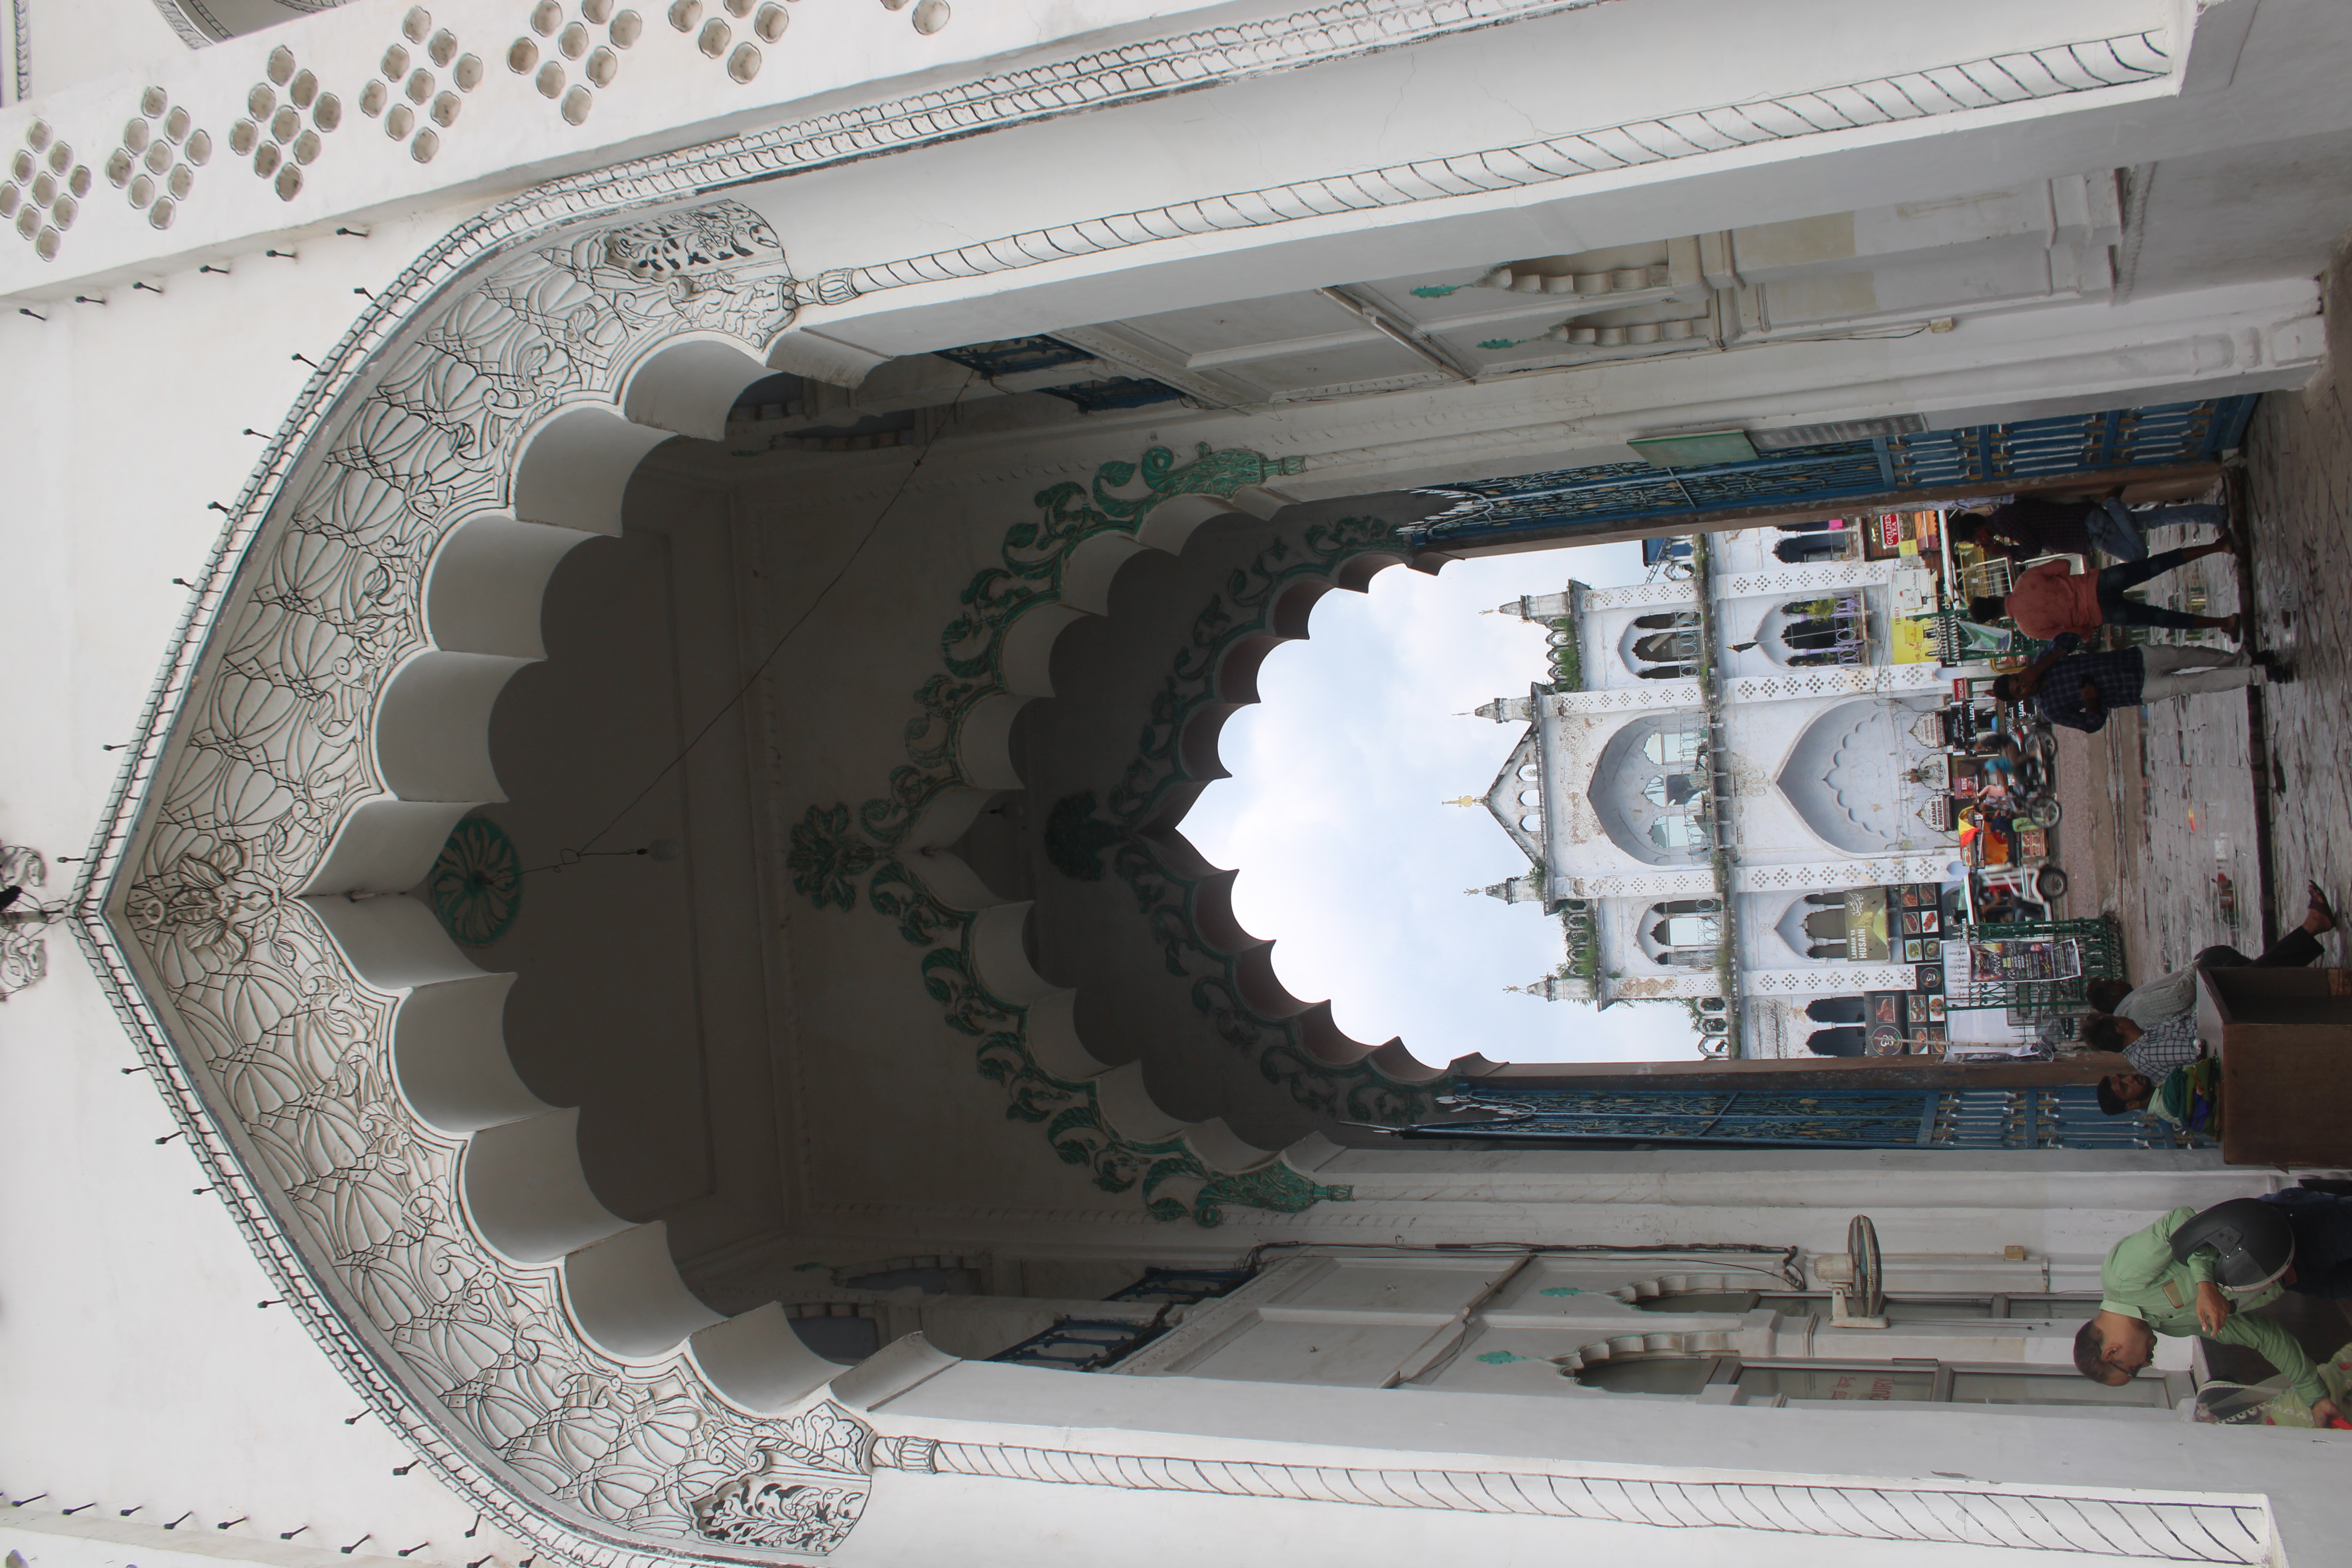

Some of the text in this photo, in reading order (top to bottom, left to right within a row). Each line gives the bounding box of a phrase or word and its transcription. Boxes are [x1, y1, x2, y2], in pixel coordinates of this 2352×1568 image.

[1884, 514, 1893, 544] GOLDEN
[1857, 929, 1867, 958] HUSAIN
[1869, 1377, 1894, 1400] QUIRY
